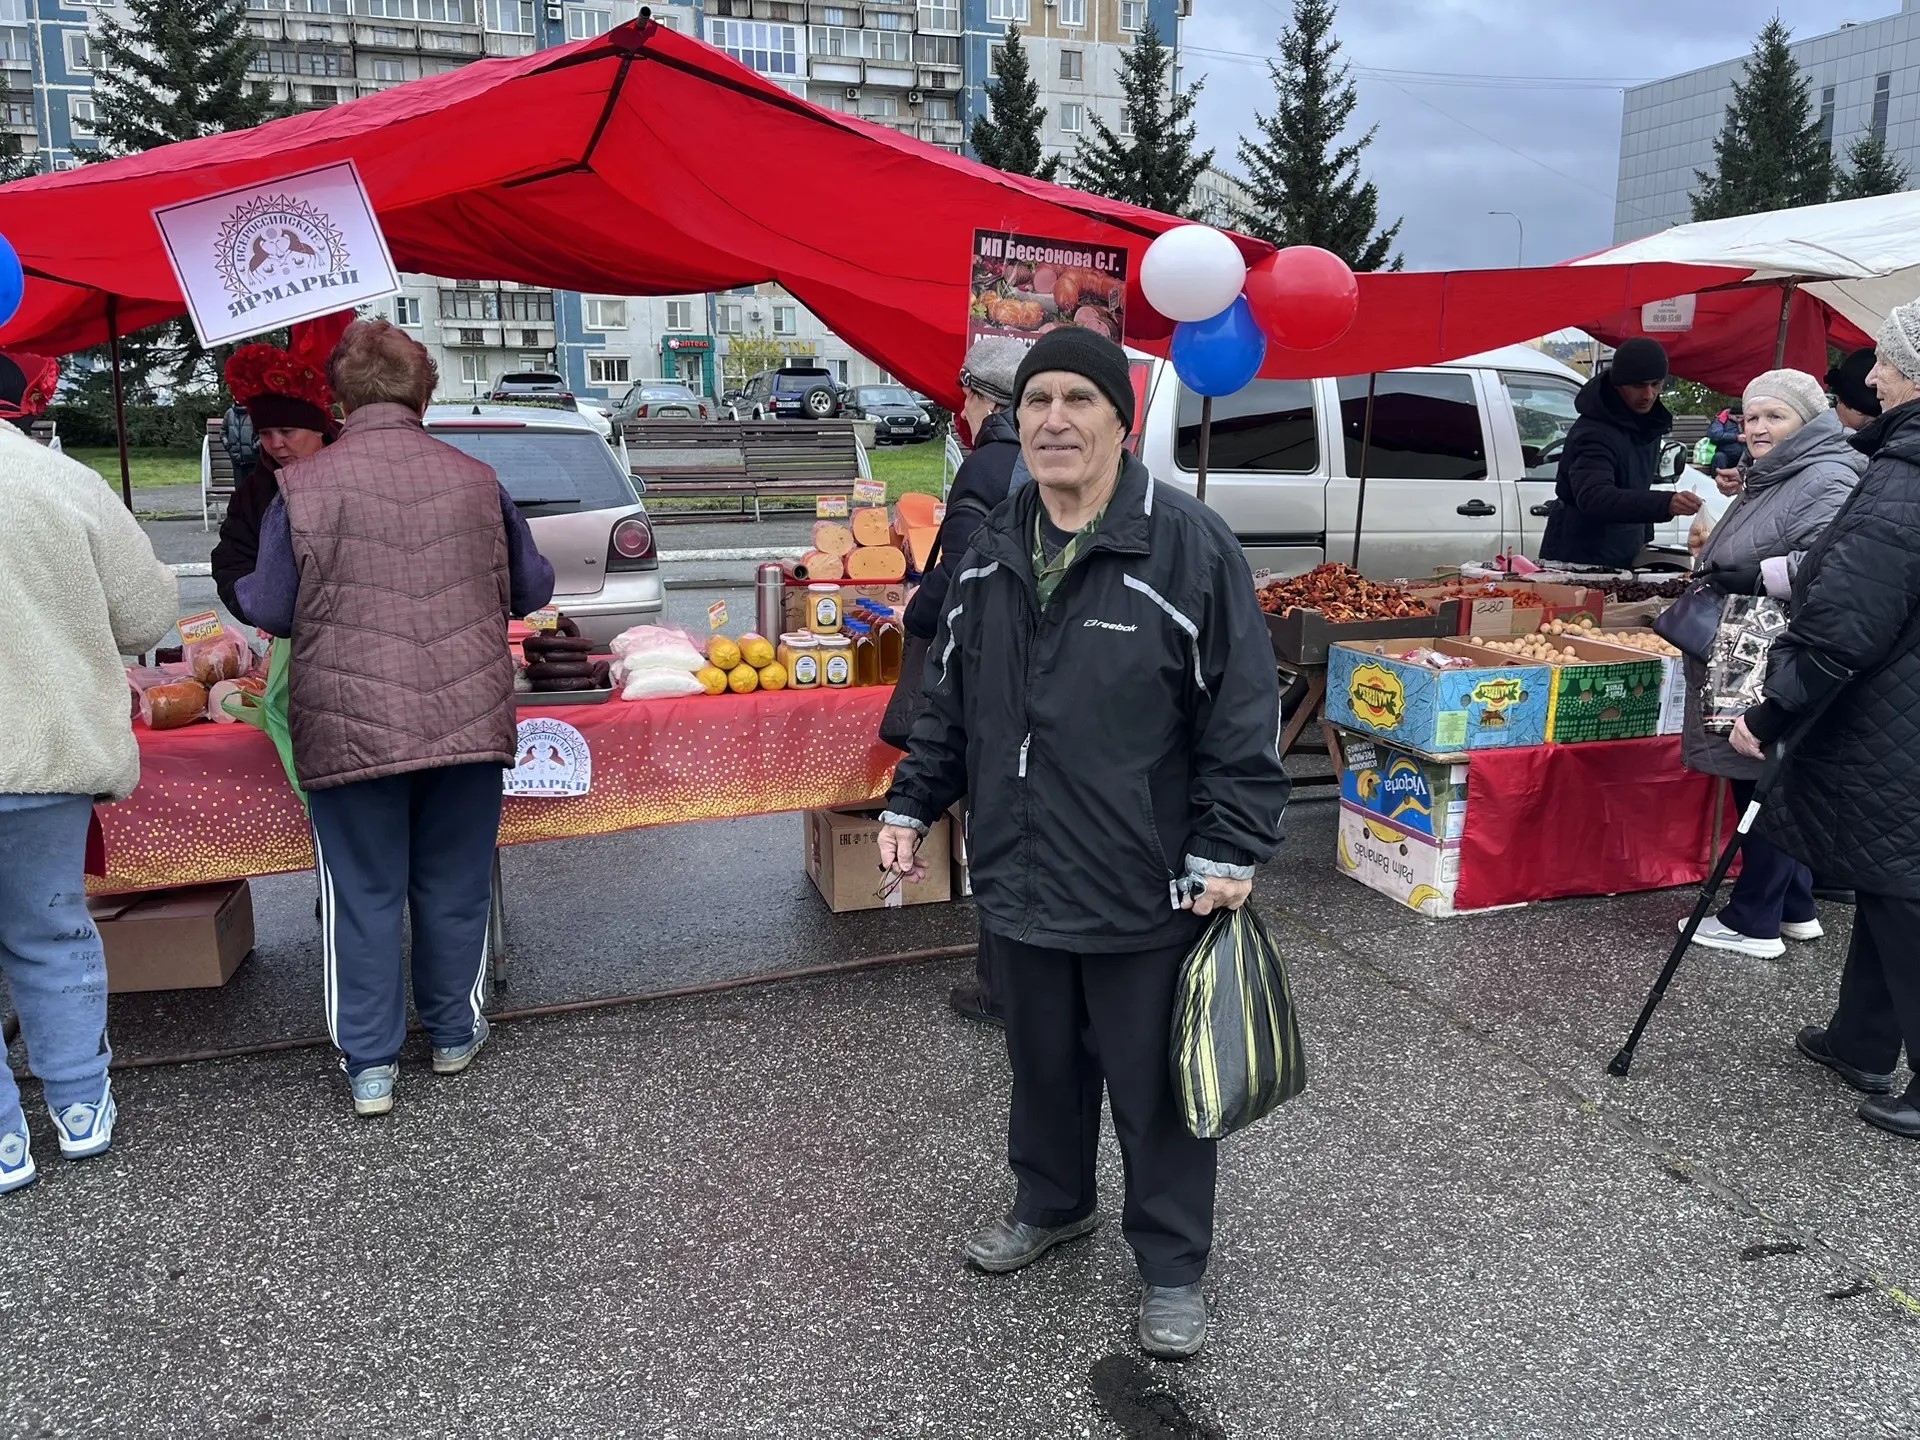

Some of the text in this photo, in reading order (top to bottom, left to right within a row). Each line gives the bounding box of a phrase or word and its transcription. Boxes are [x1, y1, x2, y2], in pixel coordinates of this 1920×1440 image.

[236, 214, 322, 263] ВСЕРОССИЙСКИЕ
[980, 236, 1120, 272] ИП Бессонова С.Г.
[227, 269, 360, 319] ЯРМАРКИ
[680, 340, 710, 348] аптека
[1477, 600, 1504, 614] 280
[1384, 773, 1427, 795] Victoria
[1354, 842, 1389, 874] Bananas
[1392, 860, 1414, 885] Palm
